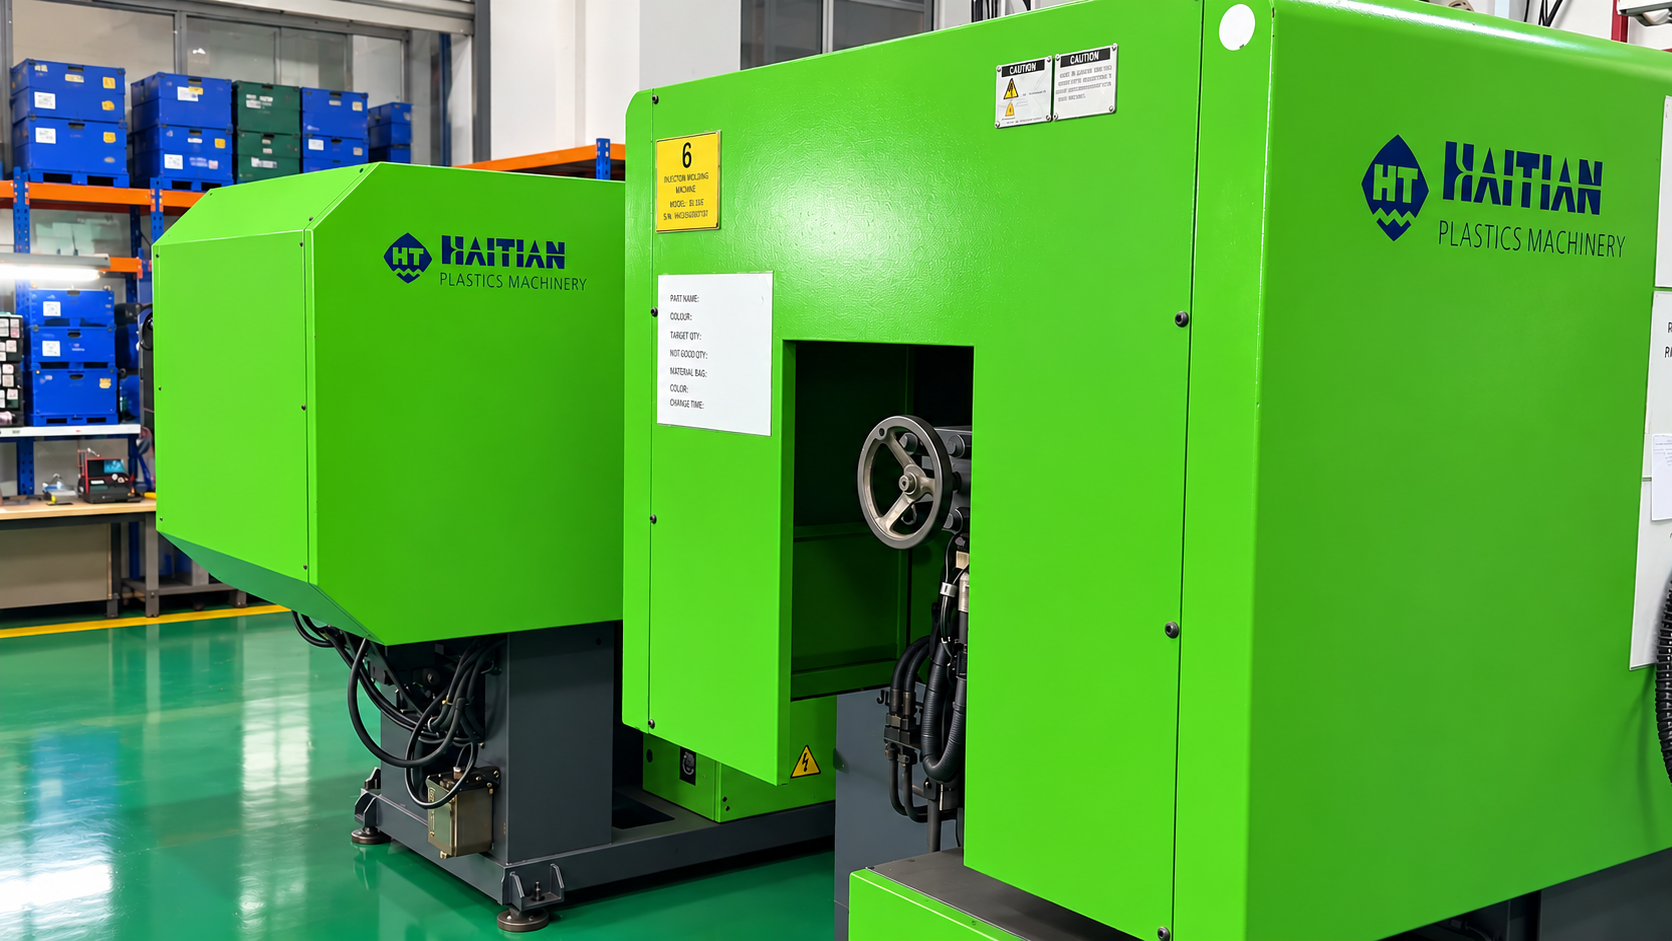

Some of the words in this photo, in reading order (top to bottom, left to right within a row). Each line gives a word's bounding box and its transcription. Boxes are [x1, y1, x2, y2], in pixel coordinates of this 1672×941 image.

[1070, 50, 1100, 65] CAUTION
[1009, 62, 1037, 75] CAUTION
[682, 142, 692, 168] 6
[1372, 163, 1418, 204] HT
[1442, 140, 1603, 216] HAITIAN
[1438, 220, 1521, 251] PLASTICS
[1527, 228, 1626, 258] MACHINERY
[392, 246, 424, 266] HT
[441, 235, 565, 269] HAITIAN
[440, 272, 503, 288] PLASTICS
[508, 275, 587, 291] MACHINERY
[669, 294, 682, 303] PART
[669, 312, 693, 321] COLOUR:
[670, 331, 689, 340] TARGET
[689, 331, 702, 341] QTY:
[669, 349, 680, 358] NOT
[680, 349, 695, 359] GOOD
[695, 350, 708, 360] QTY:
[669, 367, 694, 377] MATERIAL
[694, 368, 708, 378] BAG:
[669, 383, 689, 393] COLOR:
[669, 398, 690, 408] CHANGE
[690, 400, 705, 410] TIME:
